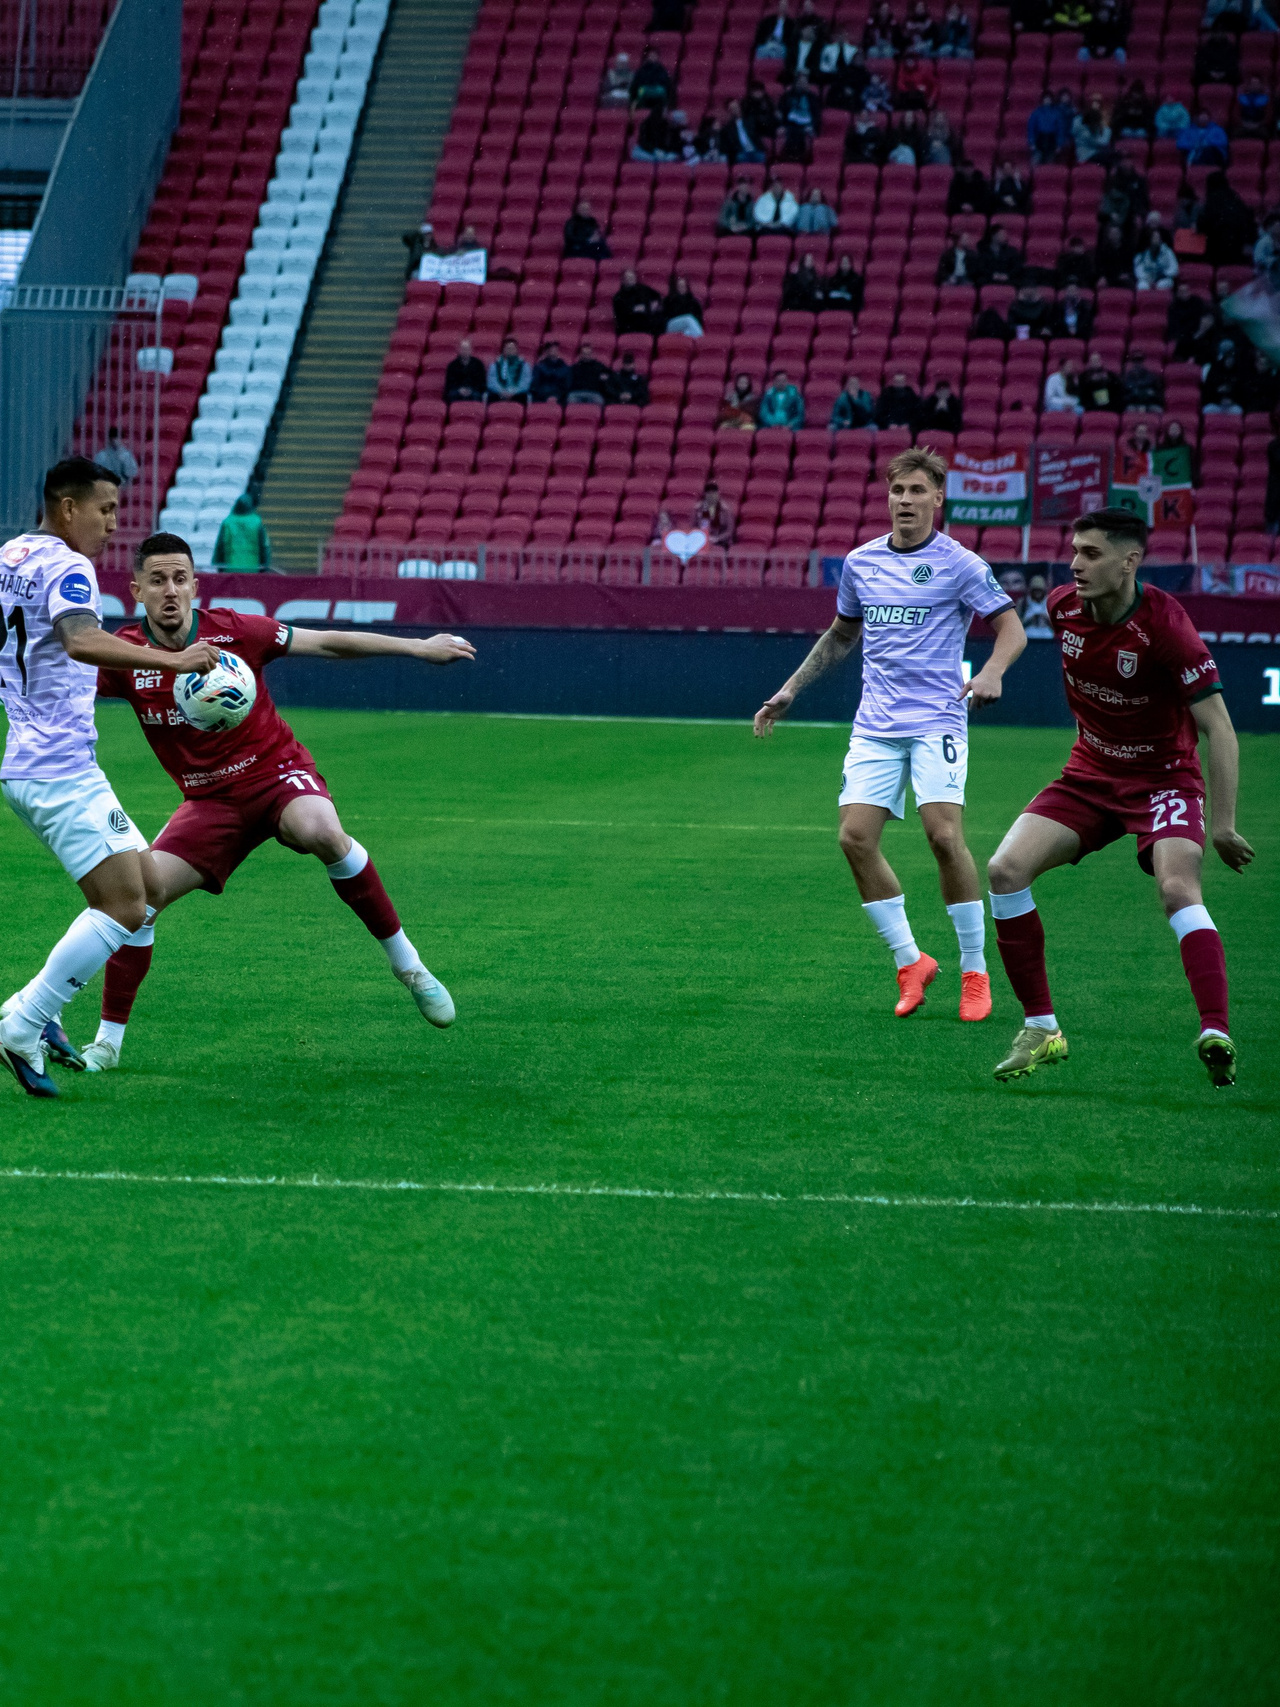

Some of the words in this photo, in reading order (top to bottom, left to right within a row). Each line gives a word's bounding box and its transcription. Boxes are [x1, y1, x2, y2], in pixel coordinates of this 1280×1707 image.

[1062, 630, 1085, 649] FON
[1062, 642, 1083, 660] BET
[135, 675, 163, 690] BET
[942, 734, 958, 764] 6
[285, 774, 321, 792] 11
[1149, 797, 1189, 833] 22
